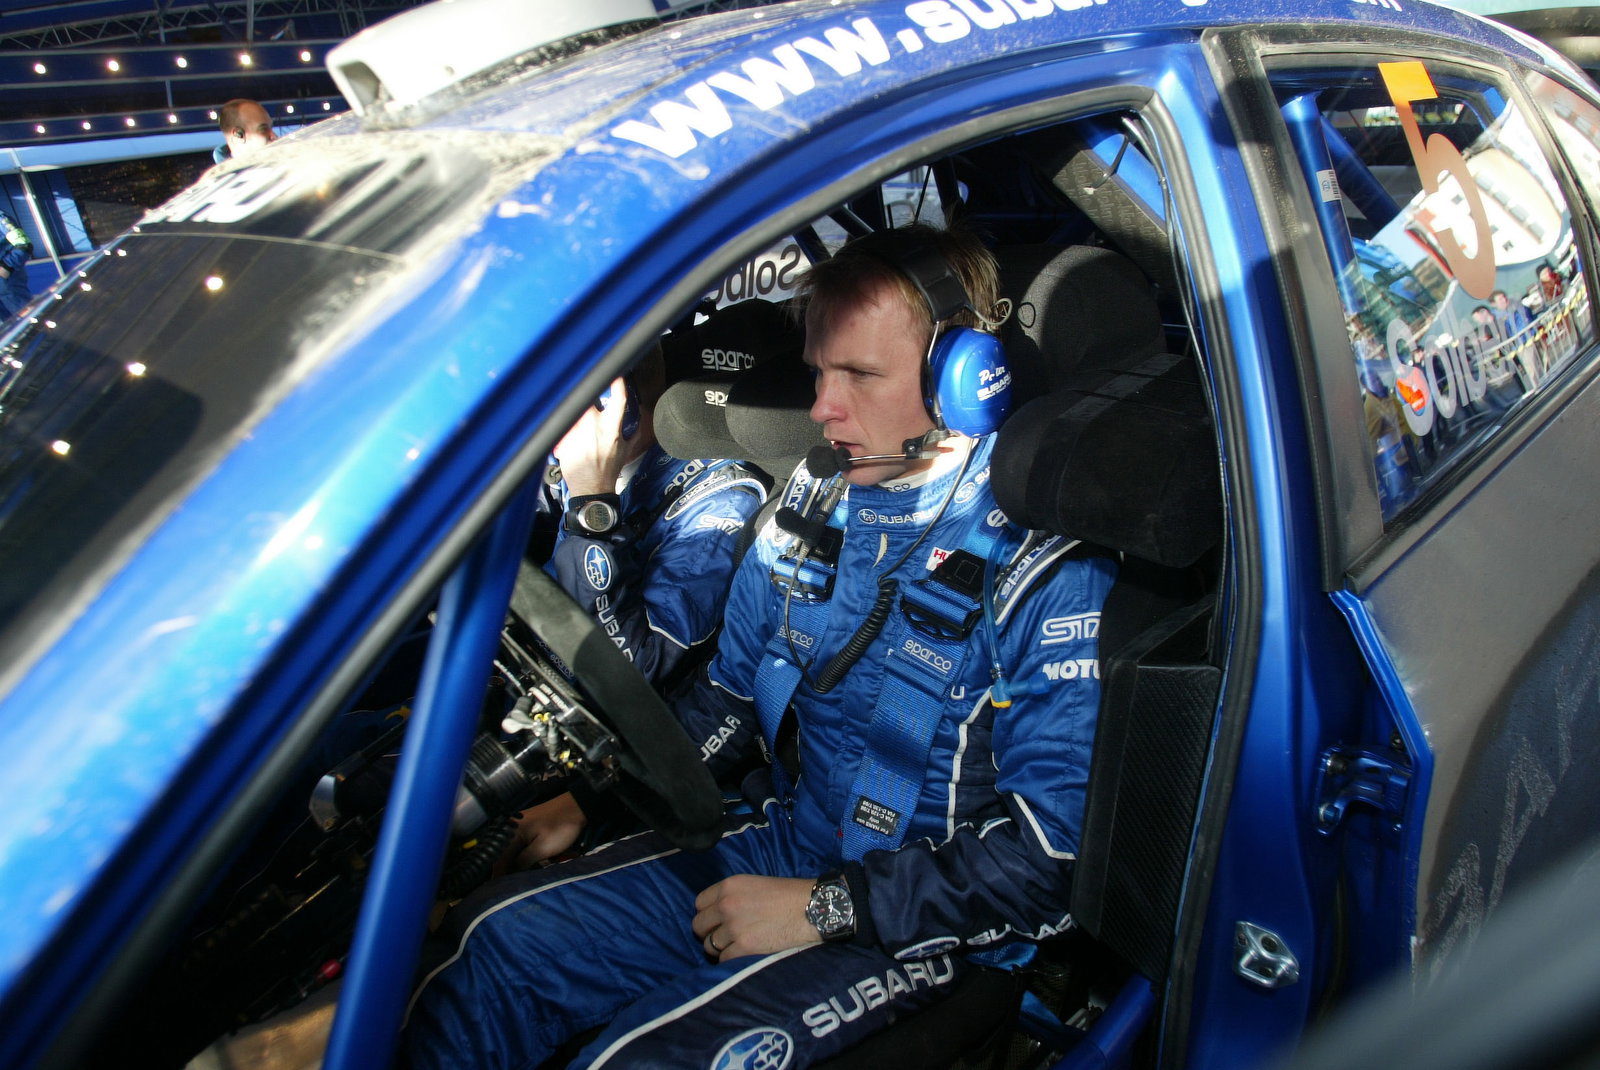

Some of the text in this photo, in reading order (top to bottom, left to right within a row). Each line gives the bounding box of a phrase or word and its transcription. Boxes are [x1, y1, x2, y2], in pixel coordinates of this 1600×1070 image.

[1378, 61, 1496, 299] 5
[902, 638, 952, 673] sparco
[802, 953, 954, 1038] SUBARU
